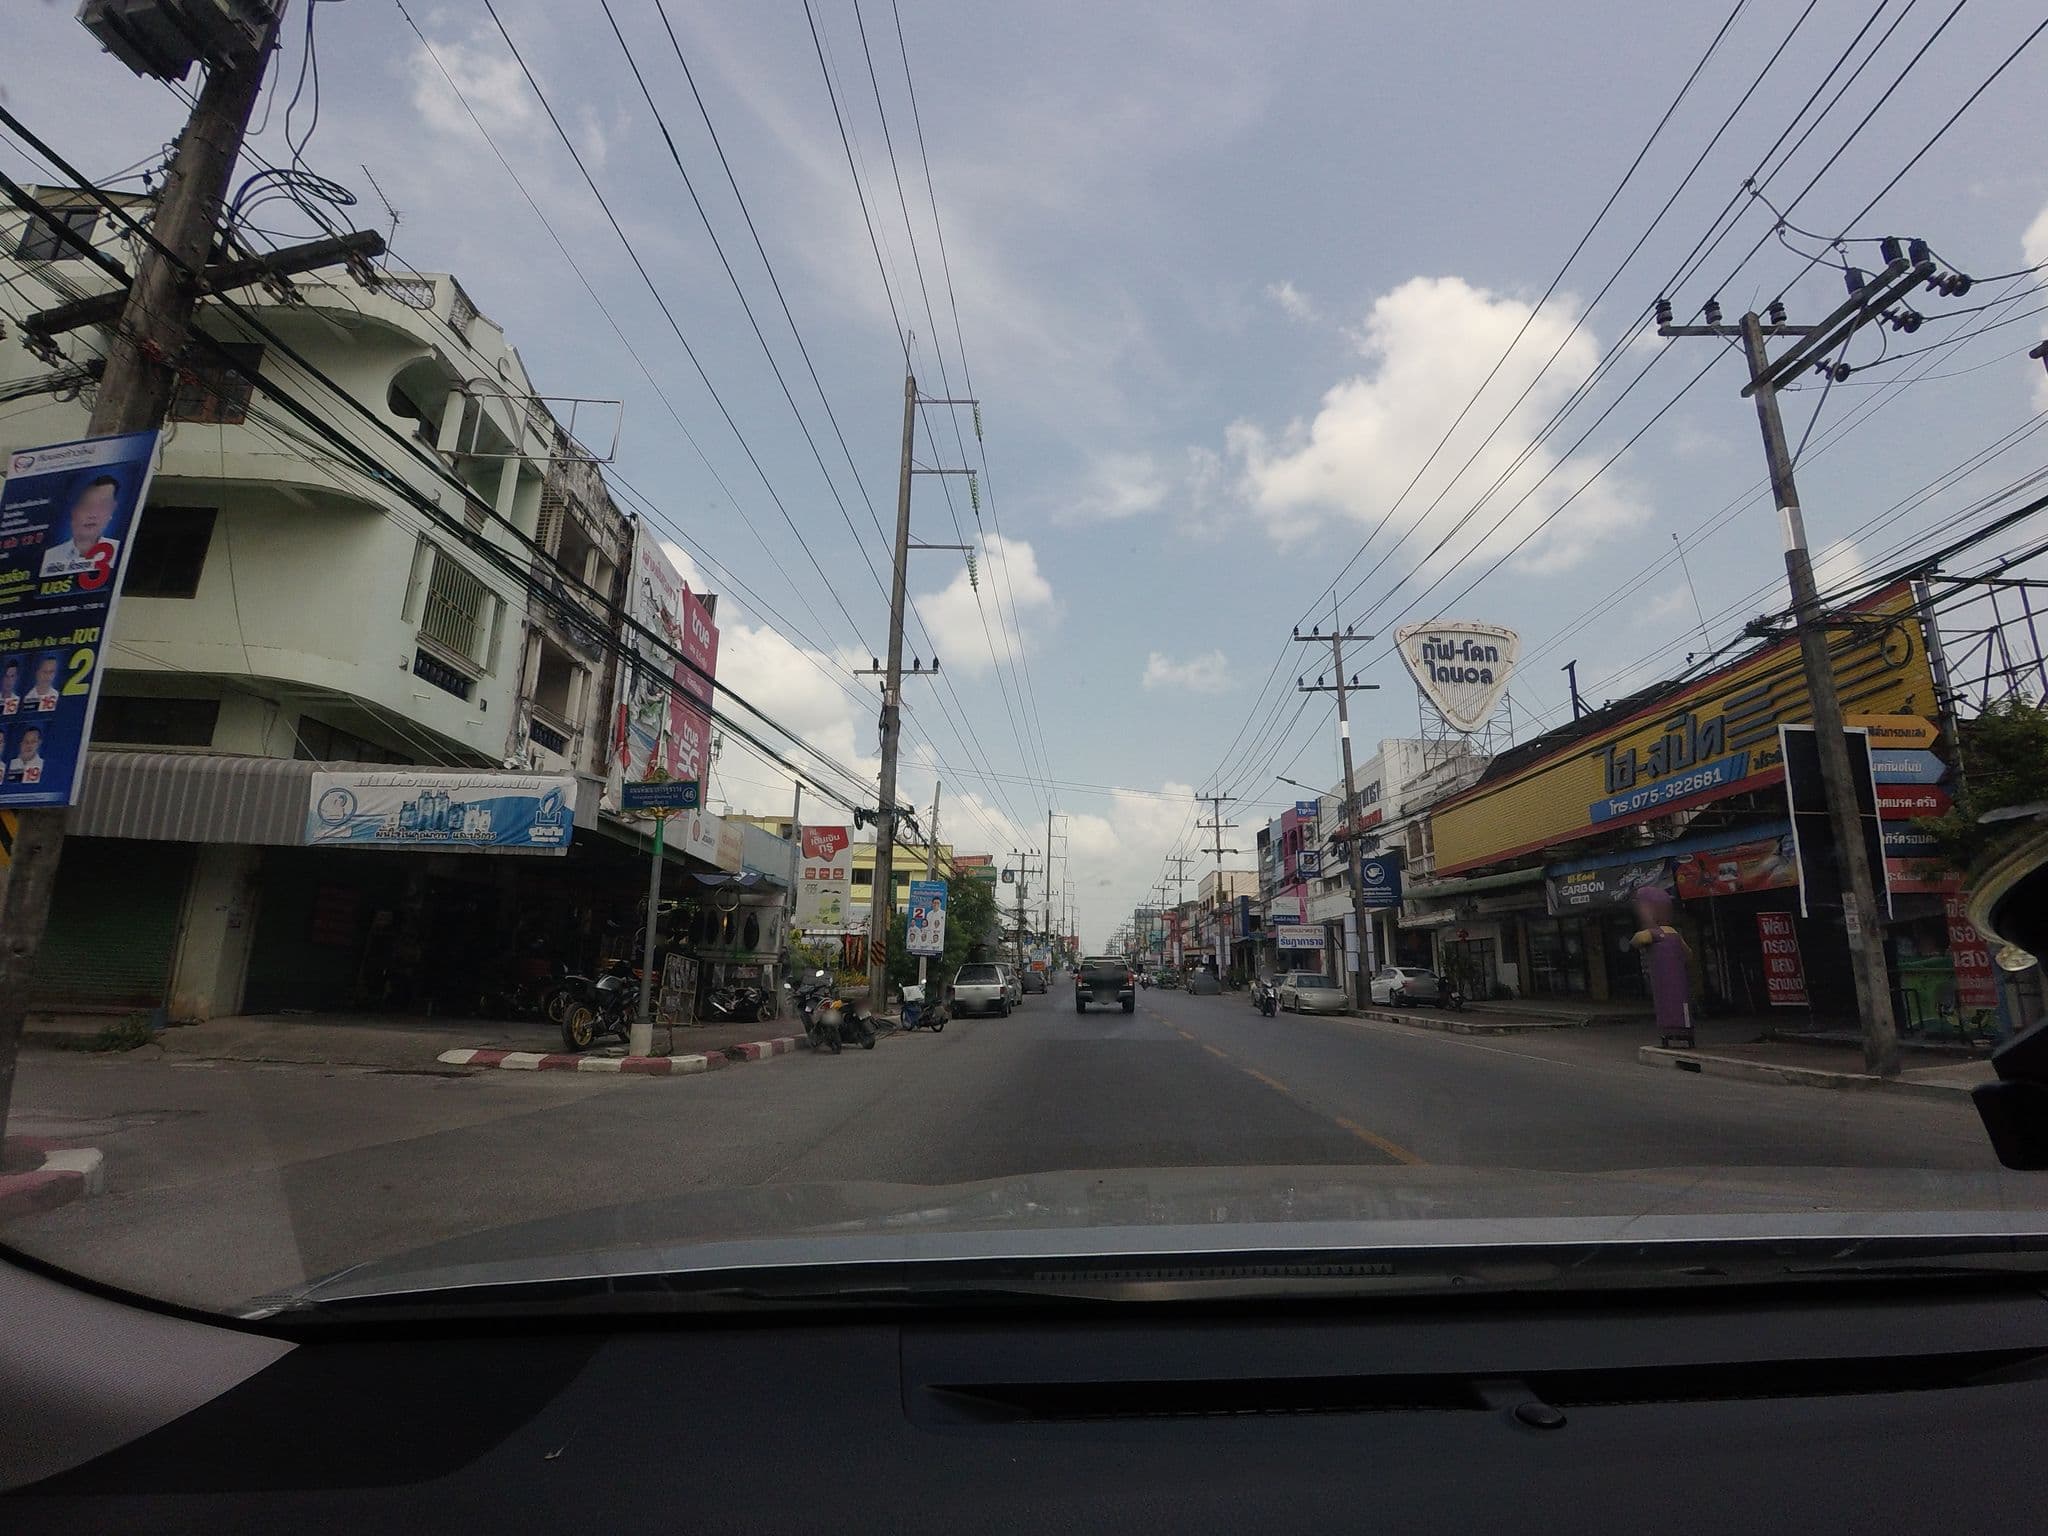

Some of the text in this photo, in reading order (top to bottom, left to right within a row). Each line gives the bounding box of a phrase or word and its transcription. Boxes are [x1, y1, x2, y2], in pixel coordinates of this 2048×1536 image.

[77, 542, 114, 591] 3
[691, 607, 711, 650] true
[62, 647, 95, 696] 2
[684, 790, 694, 799] 46
[914, 908, 923, 919] 2
